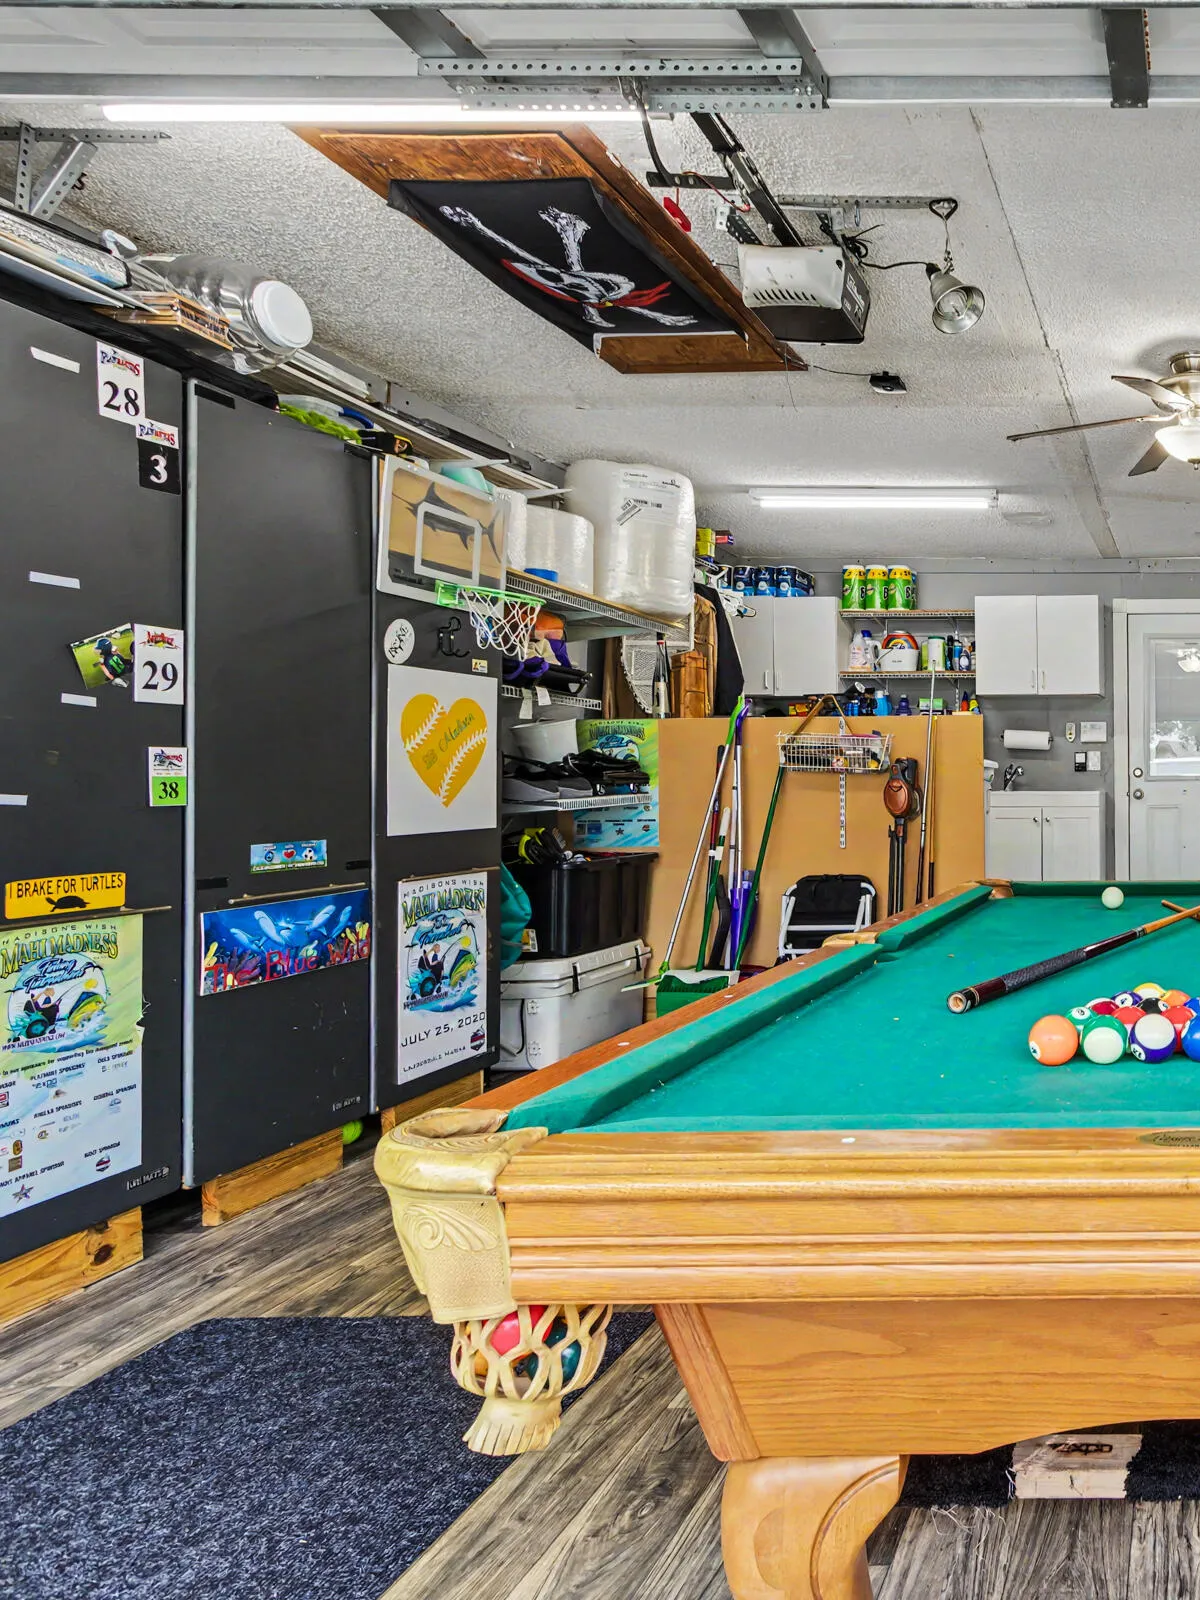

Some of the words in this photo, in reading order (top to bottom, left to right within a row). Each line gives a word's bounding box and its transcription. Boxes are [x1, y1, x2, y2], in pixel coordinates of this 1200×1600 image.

[103, 380, 140, 417] 28
[150, 454, 168, 484] 3
[142, 660, 178, 692] 29
[158, 781, 179, 799] 38
[9, 883, 13, 898] I
[17, 880, 54, 898] BRAKE
[56, 878, 77, 894] FOR
[80, 874, 123, 891] TURTLES
[85, 923, 117, 931] WISH
[1, 938, 48, 979] MAHI
[50, 932, 119, 960] MADNESS
[204, 963, 261, 993] The
[265, 947, 319, 981] Blue
[326, 925, 370, 967] Wild
[401, 1029, 431, 1048] JULY
[435, 1023, 454, 1037] 25,
[457, 1012, 486, 1029] 2020
